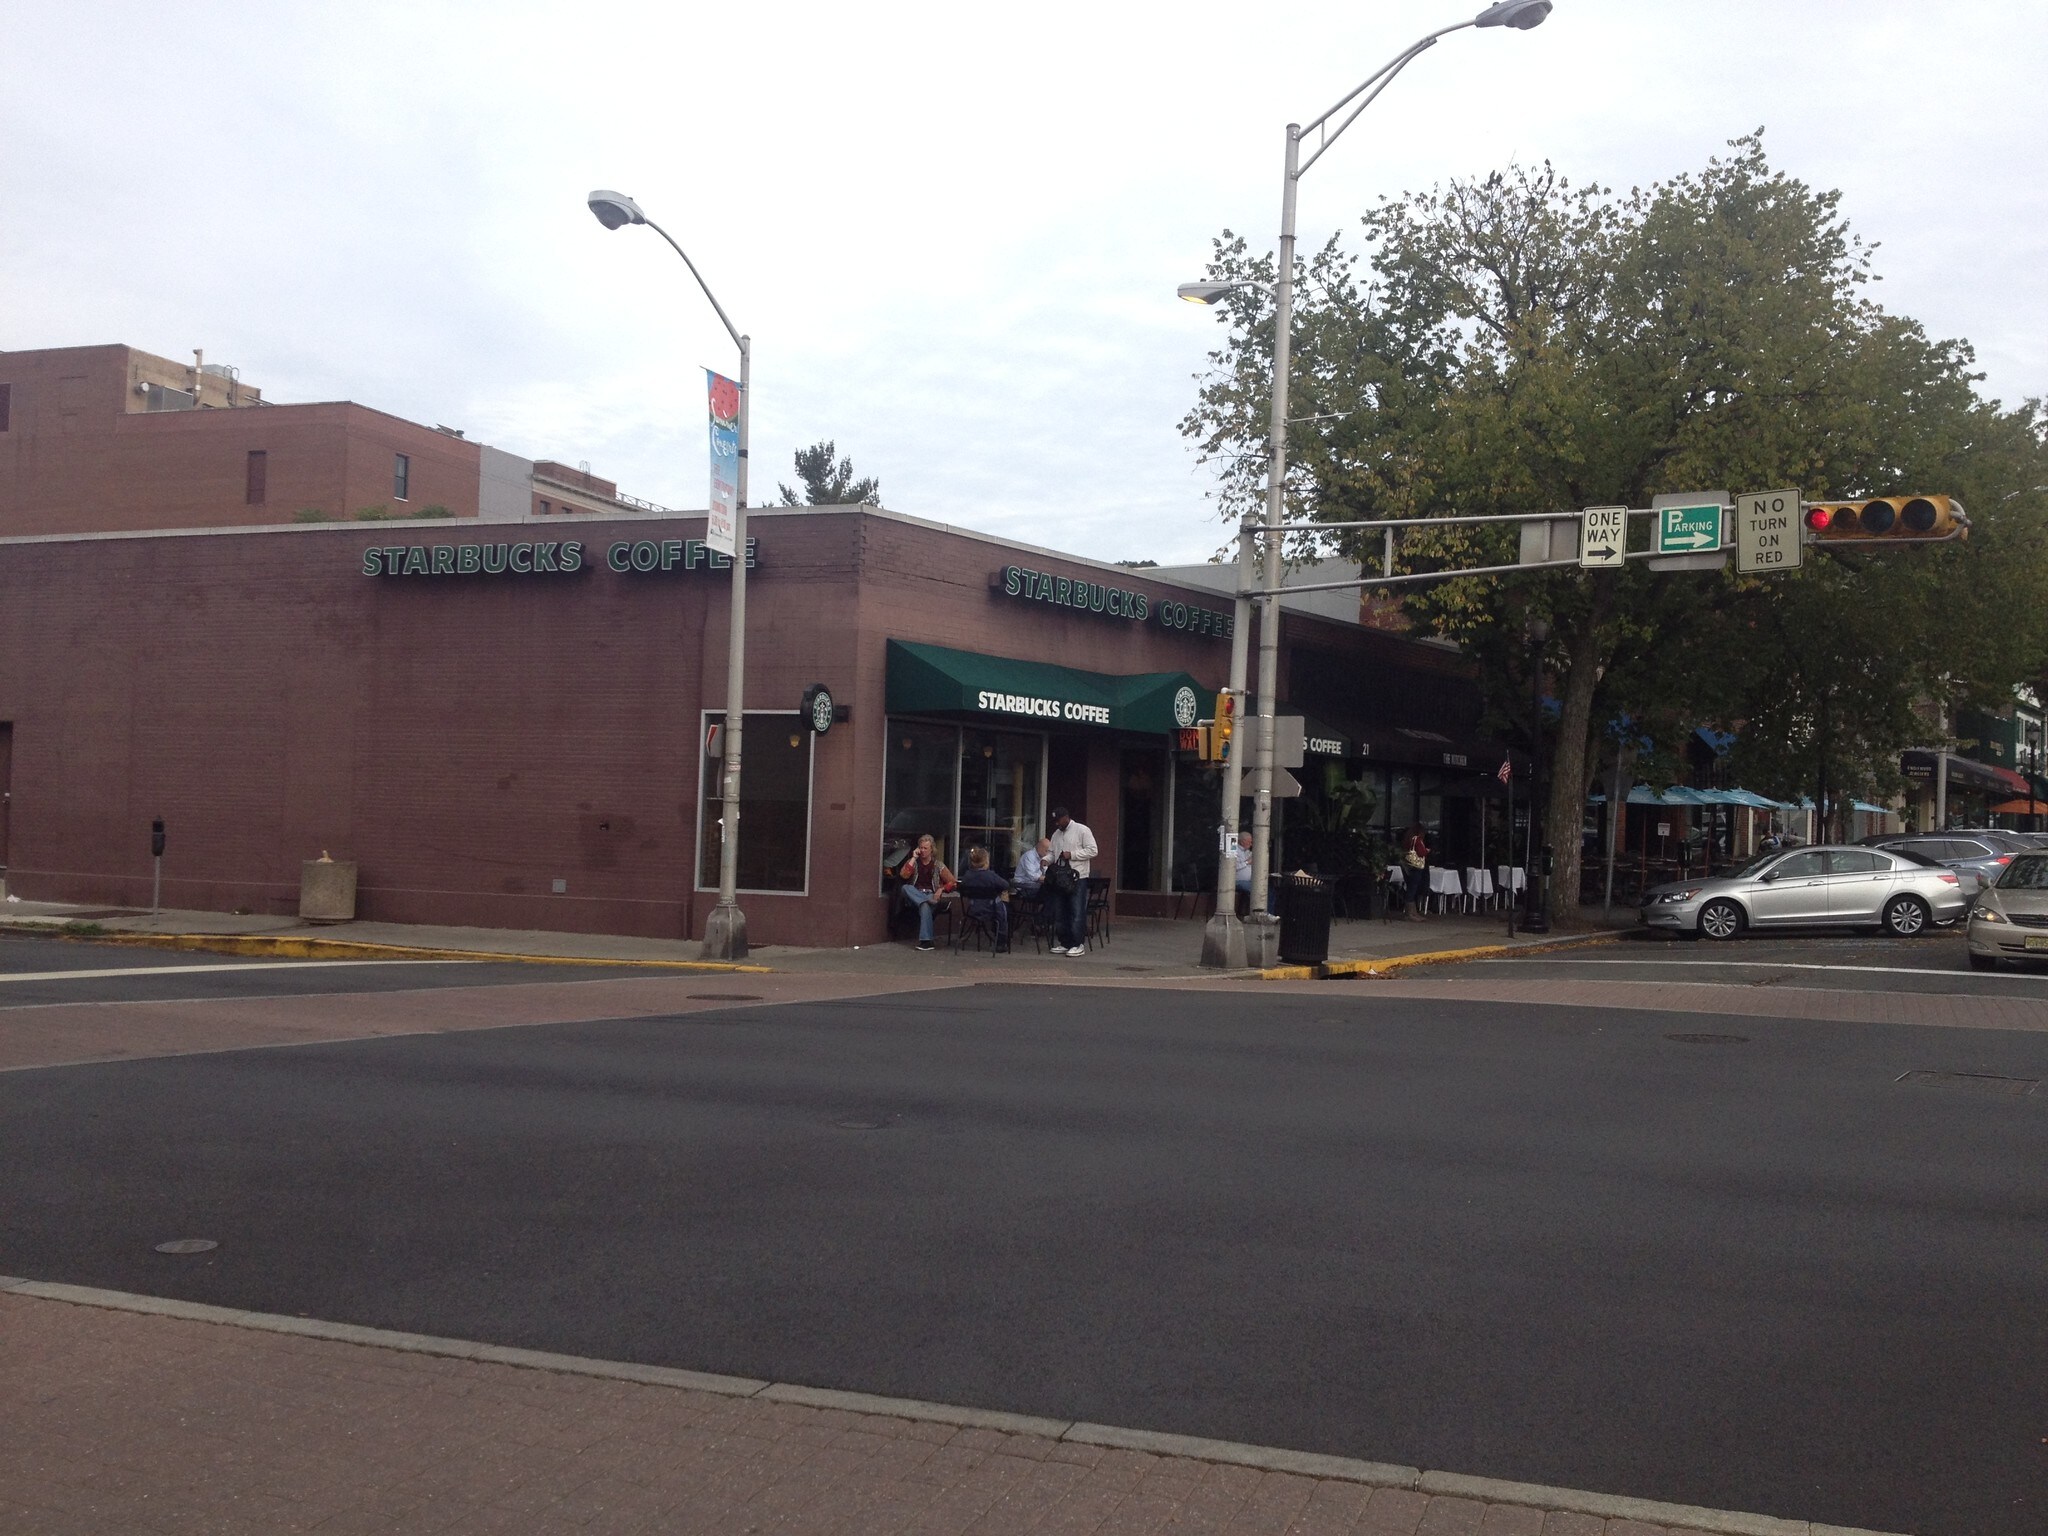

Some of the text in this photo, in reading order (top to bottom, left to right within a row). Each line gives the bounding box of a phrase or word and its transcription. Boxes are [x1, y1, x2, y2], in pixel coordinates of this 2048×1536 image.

[1754, 498, 1785, 515] NO
[1588, 511, 1621, 527] ONE
[1667, 510, 1713, 533] PARKING
[1750, 516, 1787, 532] TURN
[1587, 528, 1621, 543] WAY
[1759, 535, 1780, 547] ON
[362, 541, 582, 576] STARBUCKS
[1755, 550, 1783, 565] RED
[1005, 565, 1235, 640] STARBUCKS COFFEE
[978, 690, 1110, 724] STARBUCKS COFFEE
[1310, 737, 1342, 755] COFFEE
[1362, 743, 1370, 756] 21
